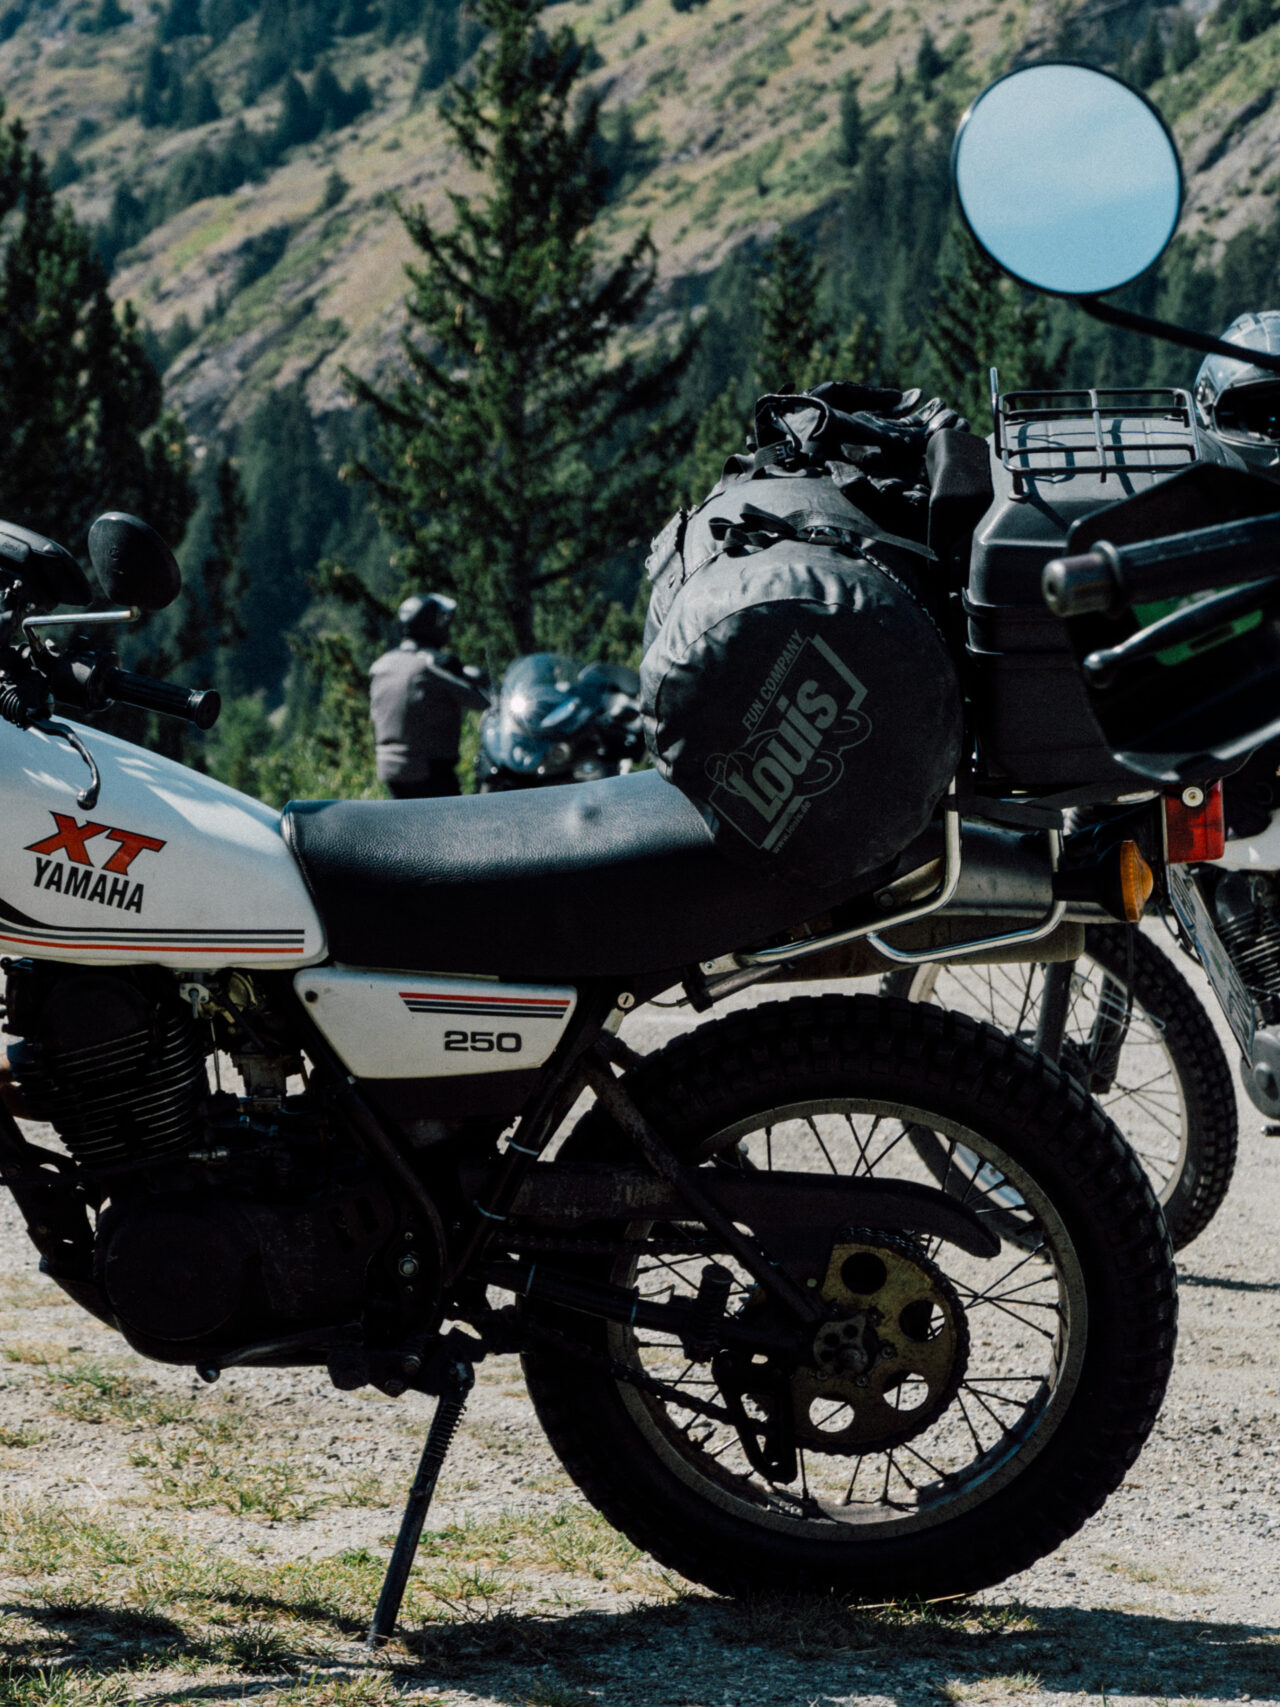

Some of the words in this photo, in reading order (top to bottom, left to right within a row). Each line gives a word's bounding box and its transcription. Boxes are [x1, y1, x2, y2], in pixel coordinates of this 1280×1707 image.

[742, 700, 765, 731] FUN
[760, 629, 804, 700] COMPANY
[728, 679, 838, 822] Louis
[24, 811, 167, 876] XT
[33, 857, 145, 914] YAMAHA
[444, 1031, 522, 1053] 250
